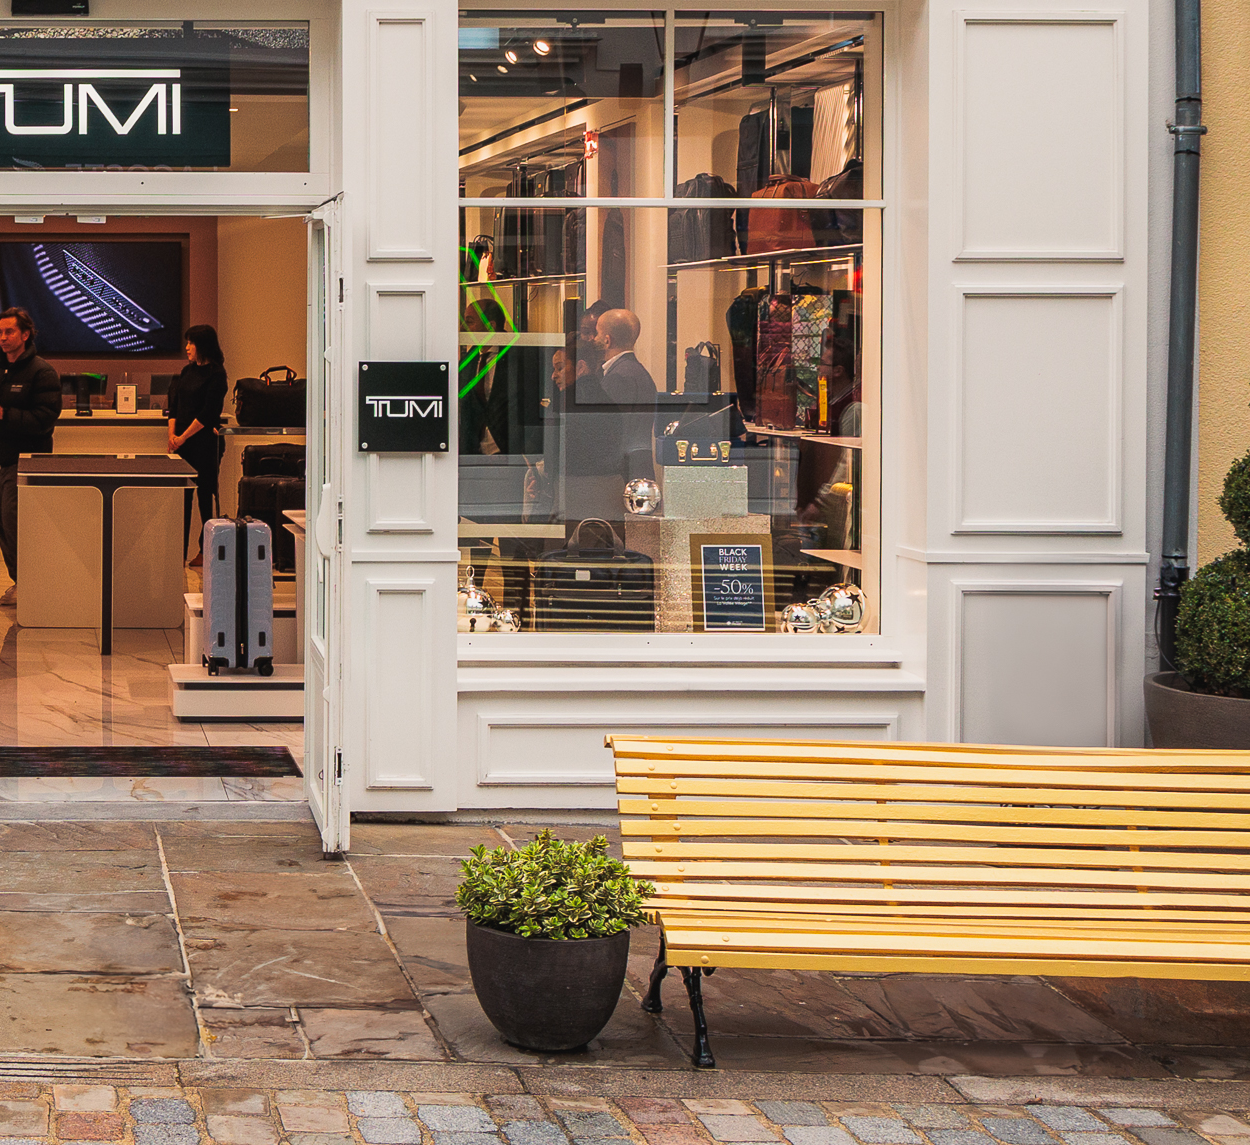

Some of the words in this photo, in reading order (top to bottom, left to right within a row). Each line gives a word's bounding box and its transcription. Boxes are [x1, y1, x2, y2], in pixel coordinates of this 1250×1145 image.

[365, 395, 443, 418] TUMI
[719, 563, 748, 571] WEEK
[713, 579, 754, 595] -50%
